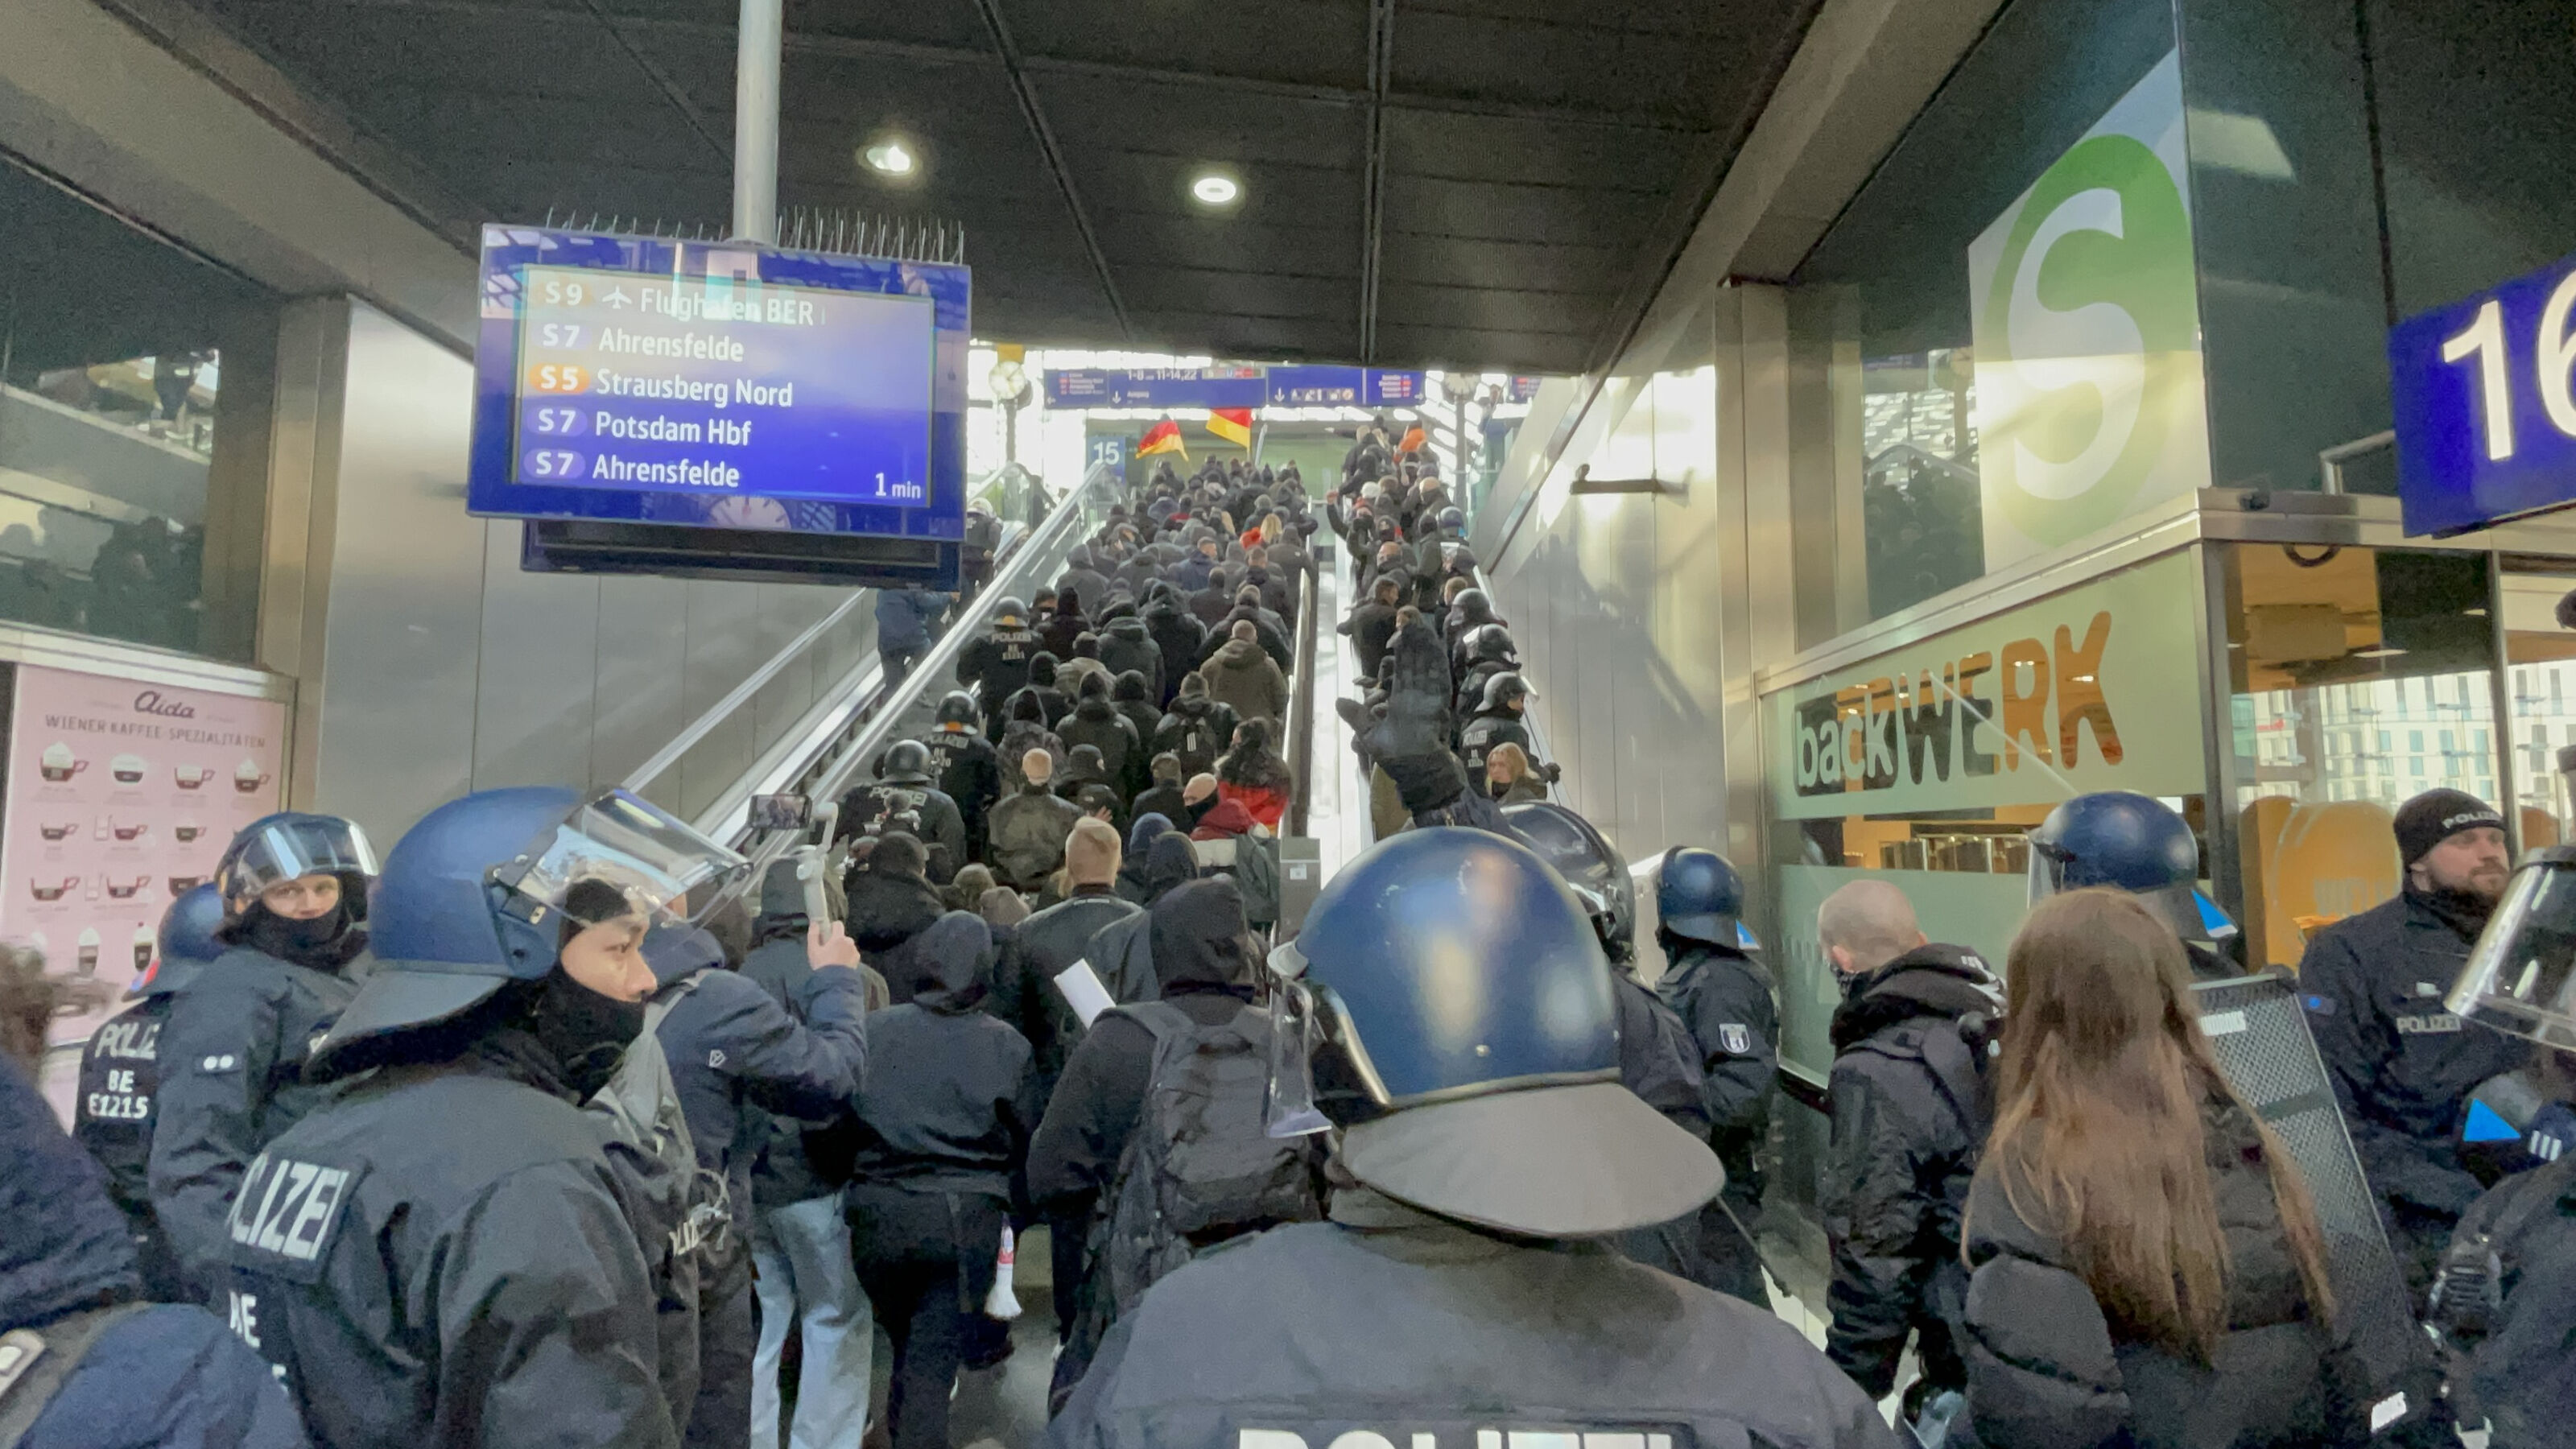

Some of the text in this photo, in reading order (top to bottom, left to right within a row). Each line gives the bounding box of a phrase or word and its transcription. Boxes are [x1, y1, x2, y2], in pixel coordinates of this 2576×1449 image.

[767, 298, 814, 326] BER
[598, 327, 744, 363] Ahrensfelde
[2007, 187, 2145, 500] S
[596, 368, 728, 408] Strausberg
[736, 378, 793, 407] Nord
[596, 411, 700, 443] Potsdam
[708, 418, 752, 446] Hbf
[1093, 441, 1120, 465] 15
[592, 454, 740, 487] Ahrensfelde
[875, 472, 886, 497] 1
[892, 481, 921, 499] min
[45, 714, 105, 734] WIENER
[109, 722, 161, 740] KAFFEE
[2396, 1014, 2461, 1034] POLIZEI
[108, 1069, 134, 1092] BE
[89, 1092, 148, 1119] E1215
